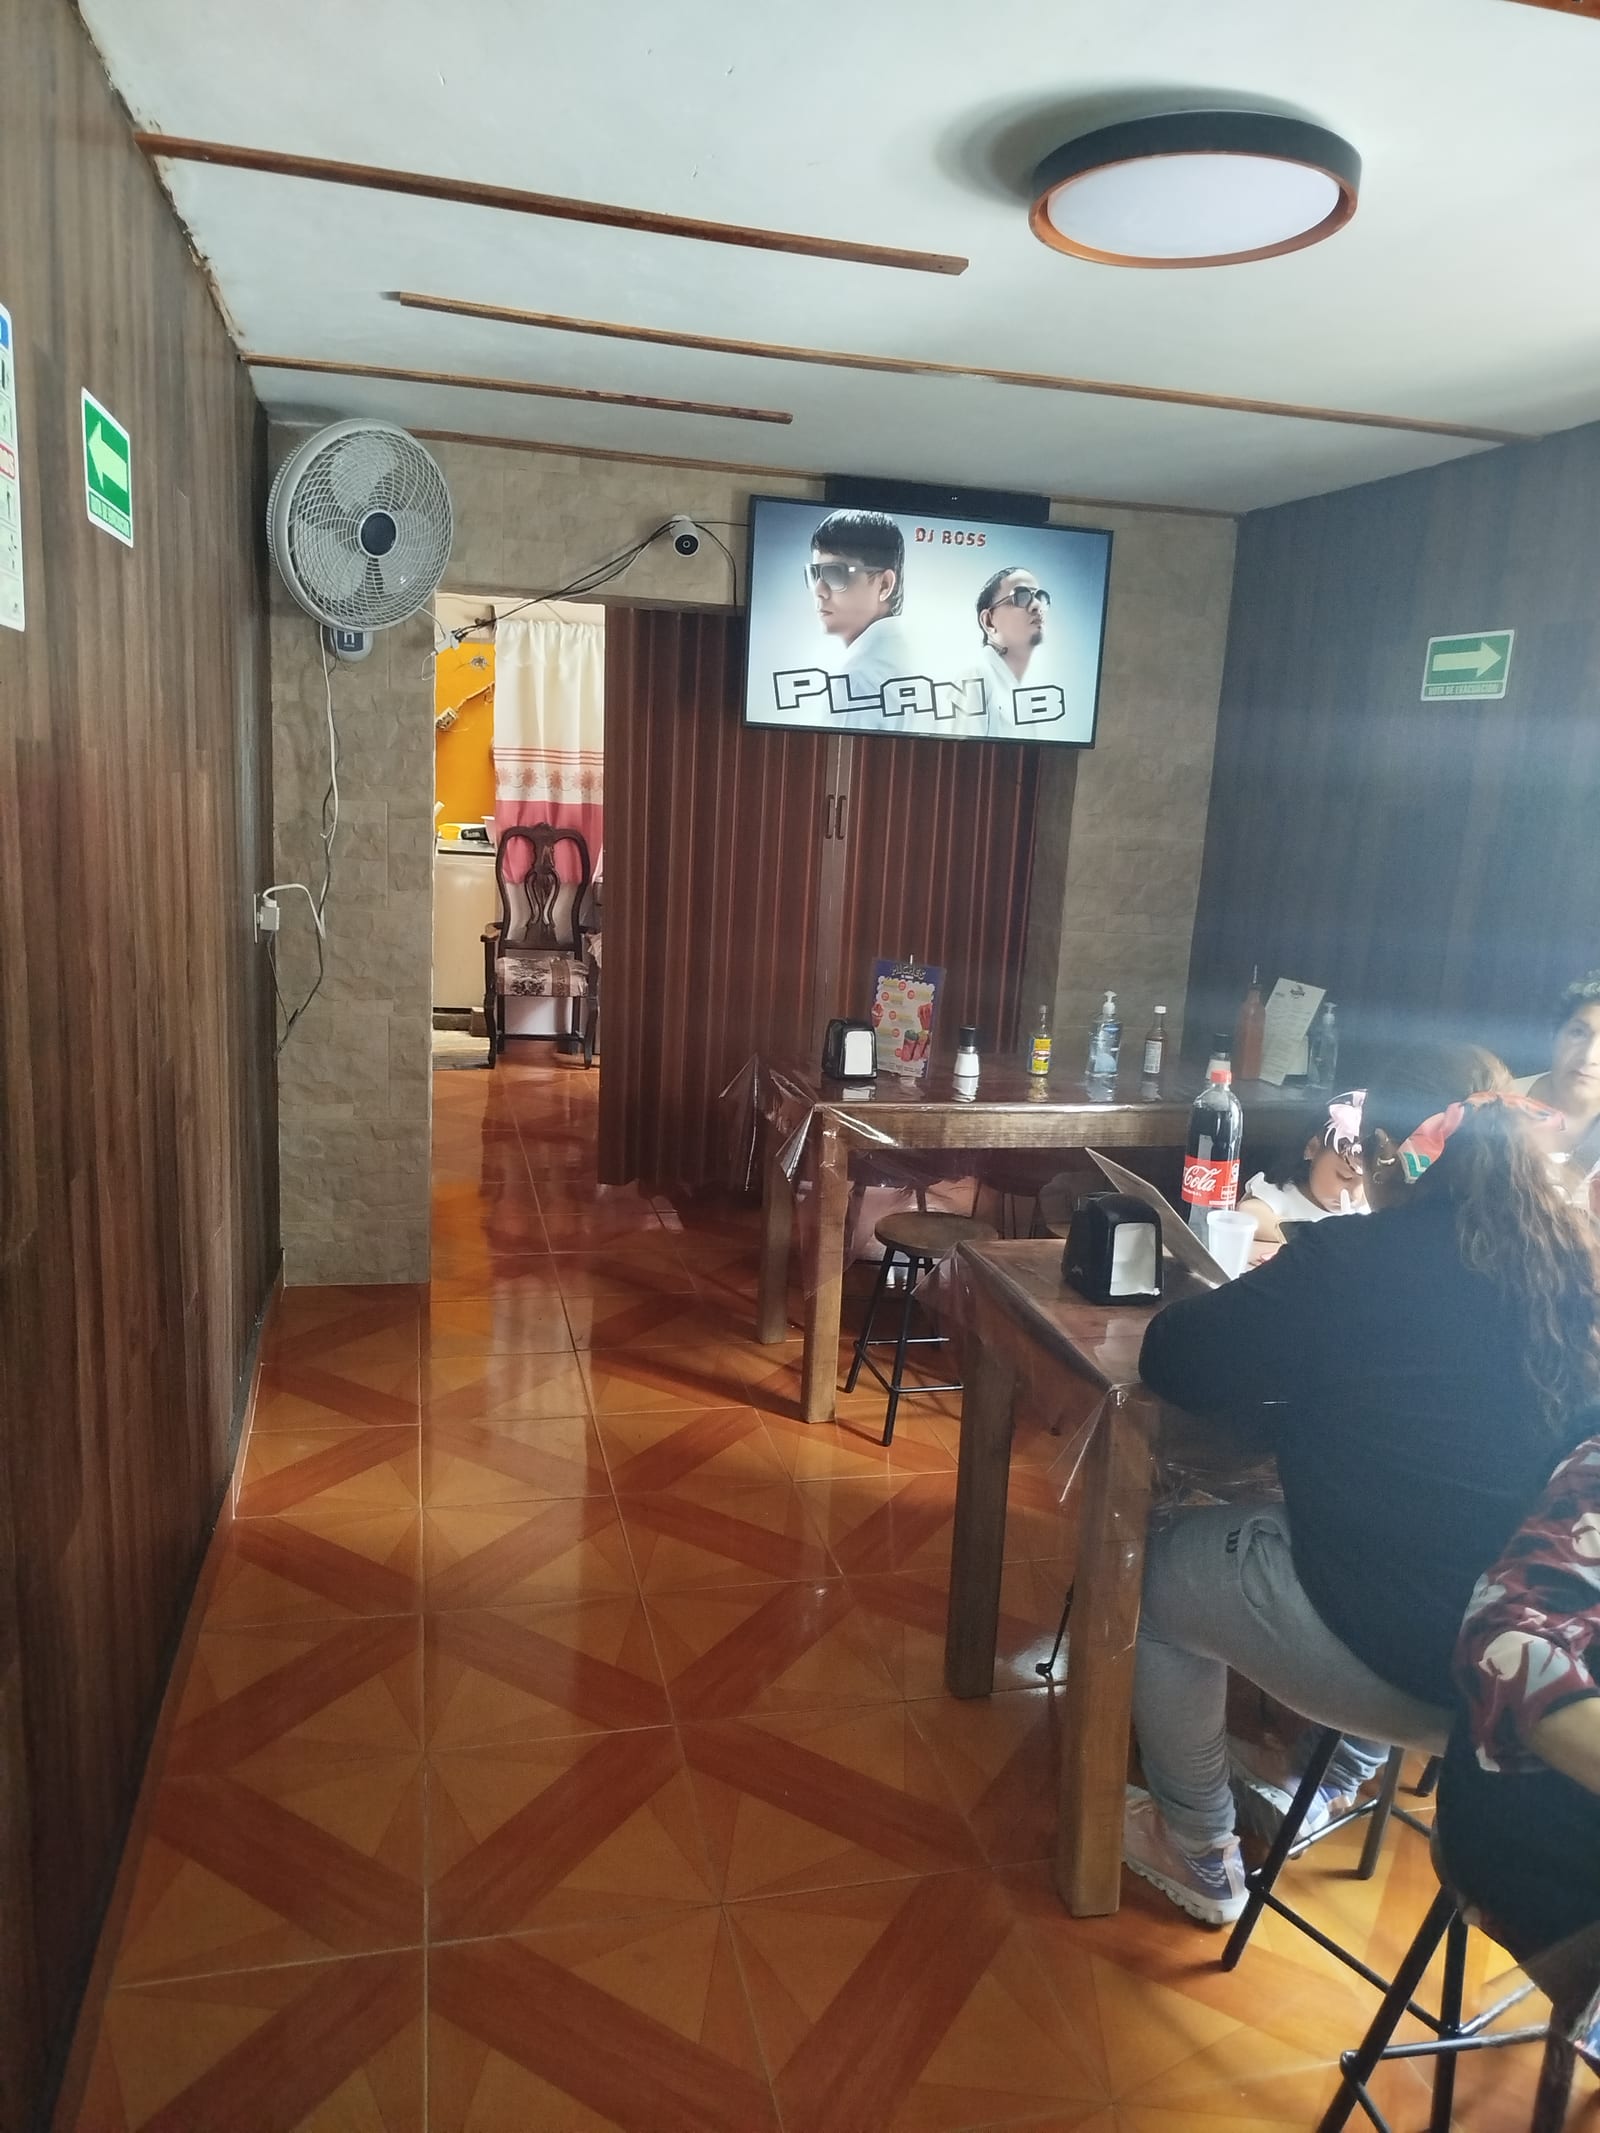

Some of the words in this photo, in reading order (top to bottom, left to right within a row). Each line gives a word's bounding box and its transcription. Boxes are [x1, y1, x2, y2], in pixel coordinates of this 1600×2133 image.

[915, 527, 934, 543] DJ
[942, 530, 986, 547] BOSS
[773, 668, 987, 720] PLAN
[1013, 685, 1066, 725] B
[1184, 1165, 1222, 1191] Cola
